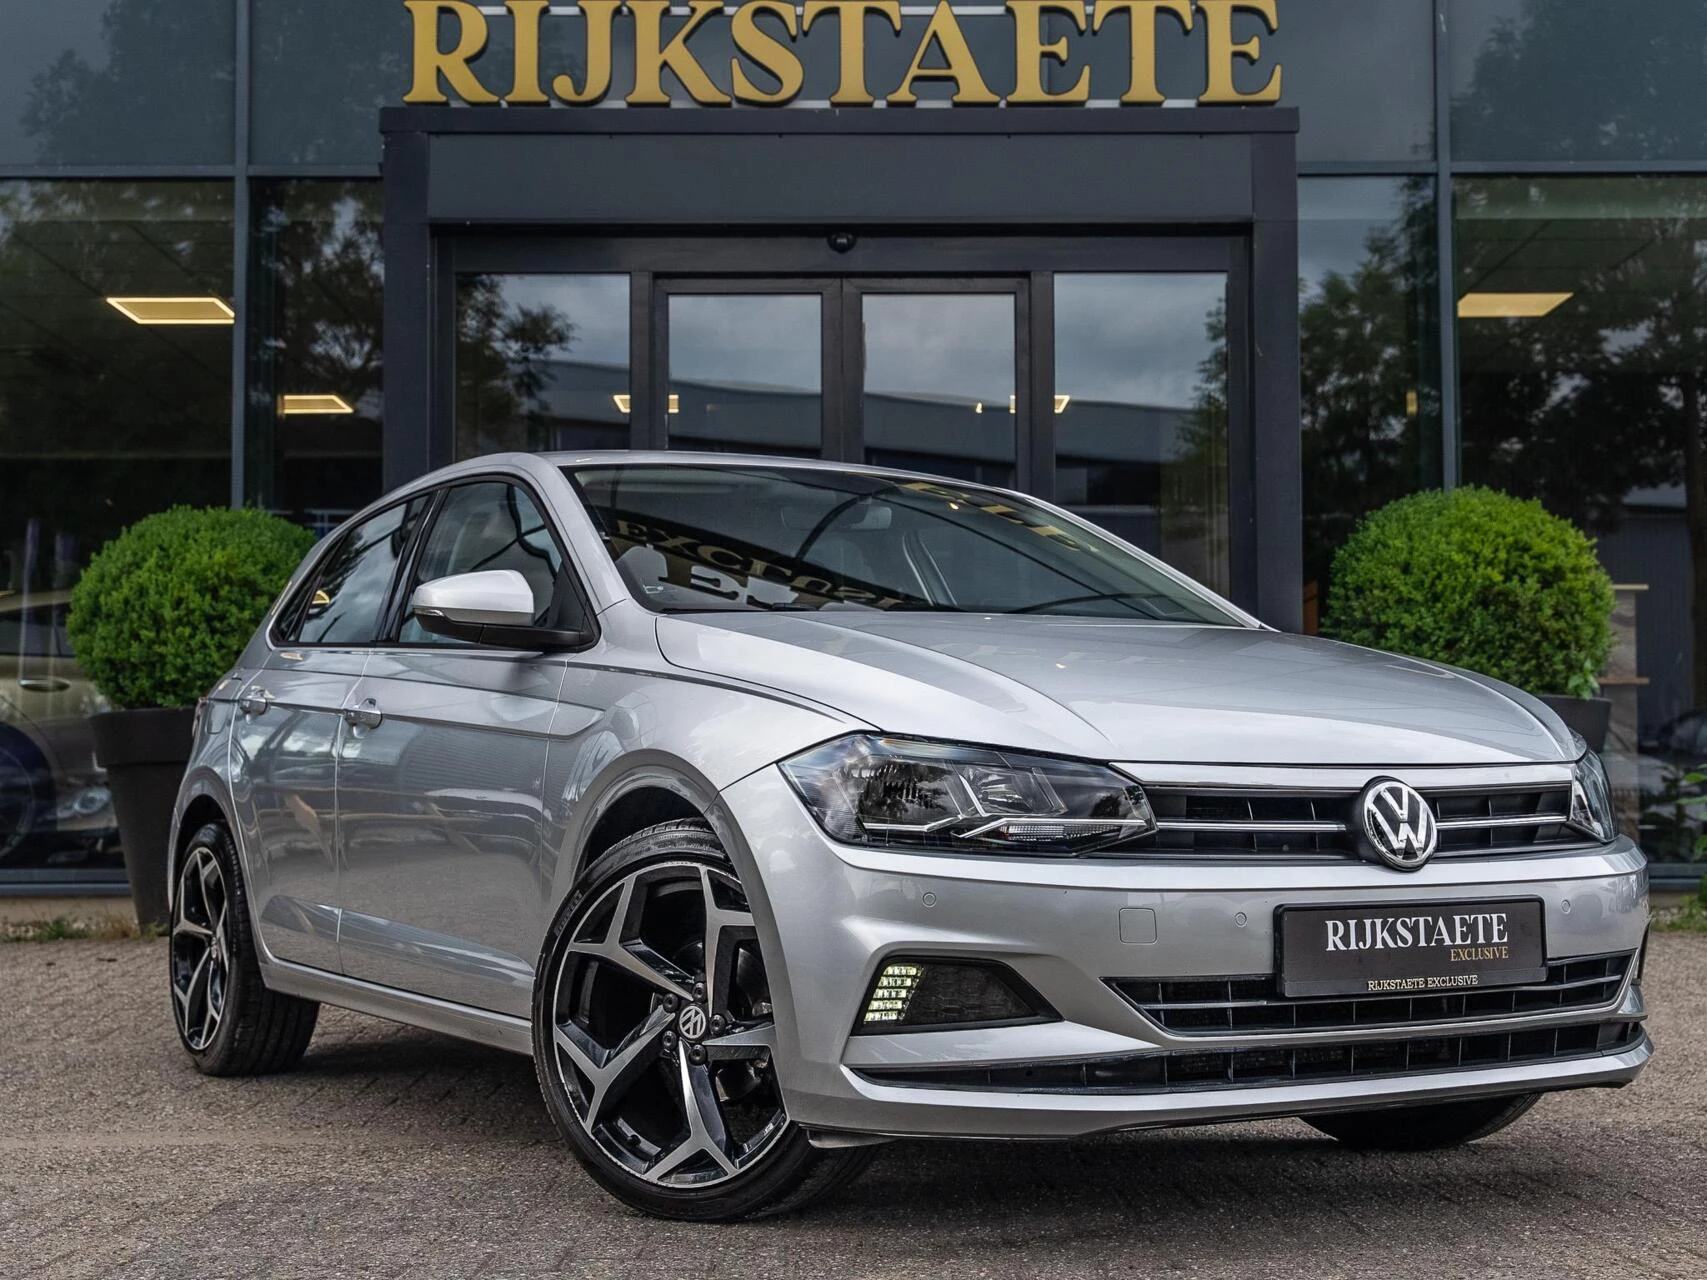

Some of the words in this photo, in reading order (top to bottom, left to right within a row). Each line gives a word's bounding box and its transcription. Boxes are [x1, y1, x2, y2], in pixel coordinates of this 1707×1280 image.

[403, 0, 1283, 105] RIJKSTAETE
[1325, 913, 1508, 951] RIJKSTAETE
[1450, 946, 1509, 961] EXCLUSIVE
[1367, 978, 1425, 991] RIJKSTAETE
[1427, 975, 1479, 988] EXCLUSIVE
